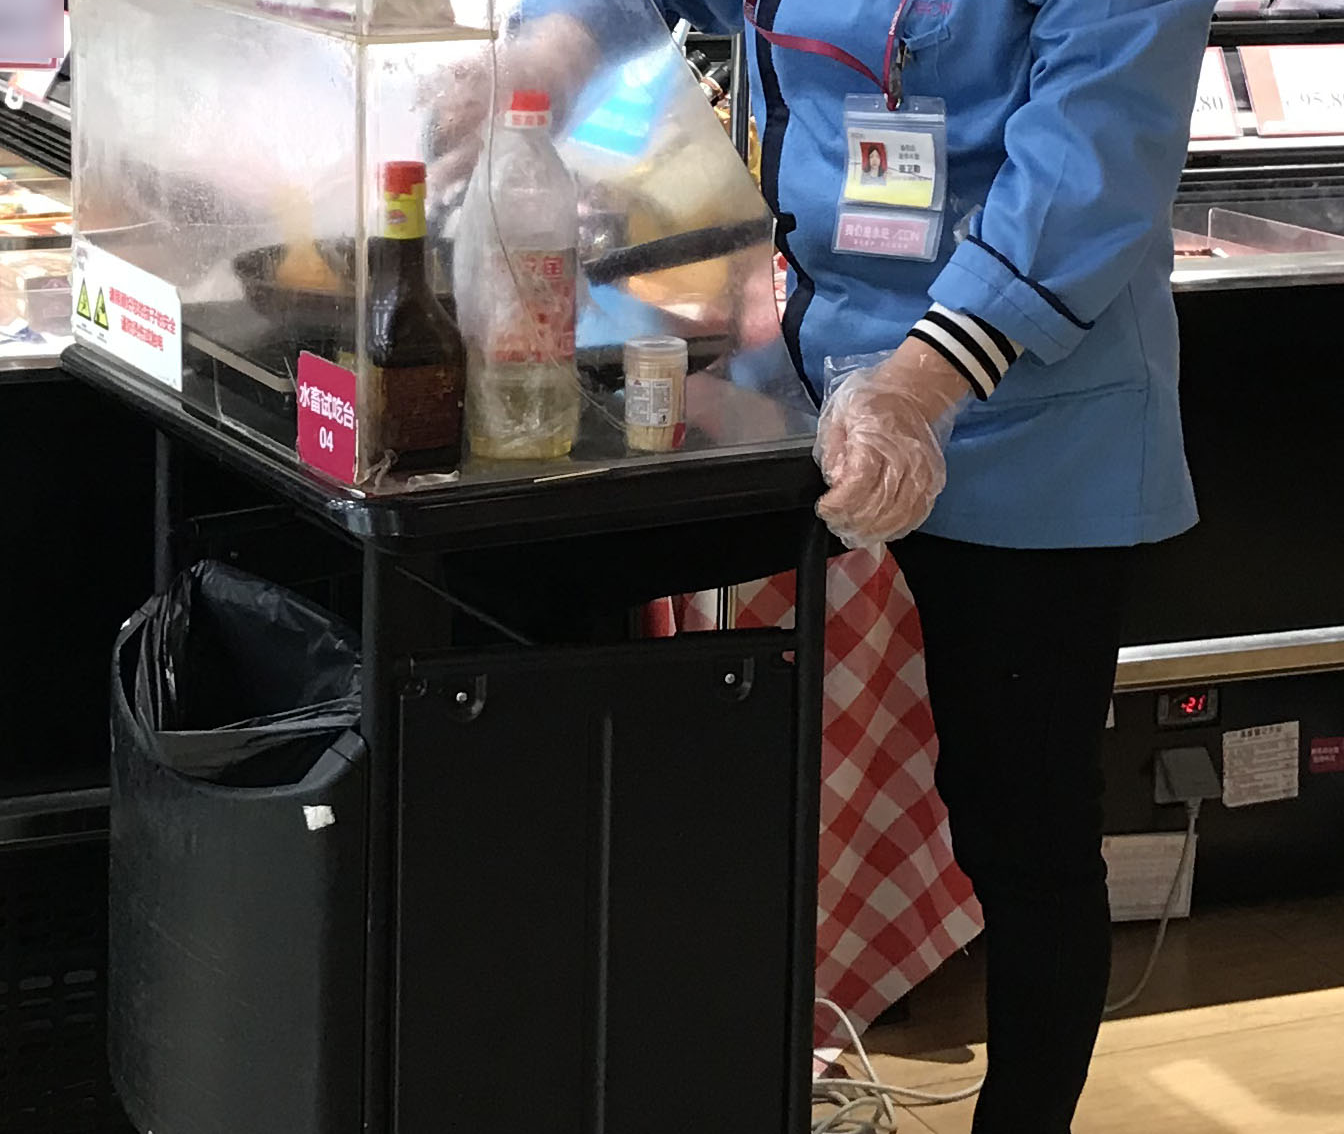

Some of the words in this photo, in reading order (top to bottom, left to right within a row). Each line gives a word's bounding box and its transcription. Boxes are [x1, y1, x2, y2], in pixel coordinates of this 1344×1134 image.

[300, 381, 355, 430] 水畜试吃台
[319, 426, 335, 453] 04
